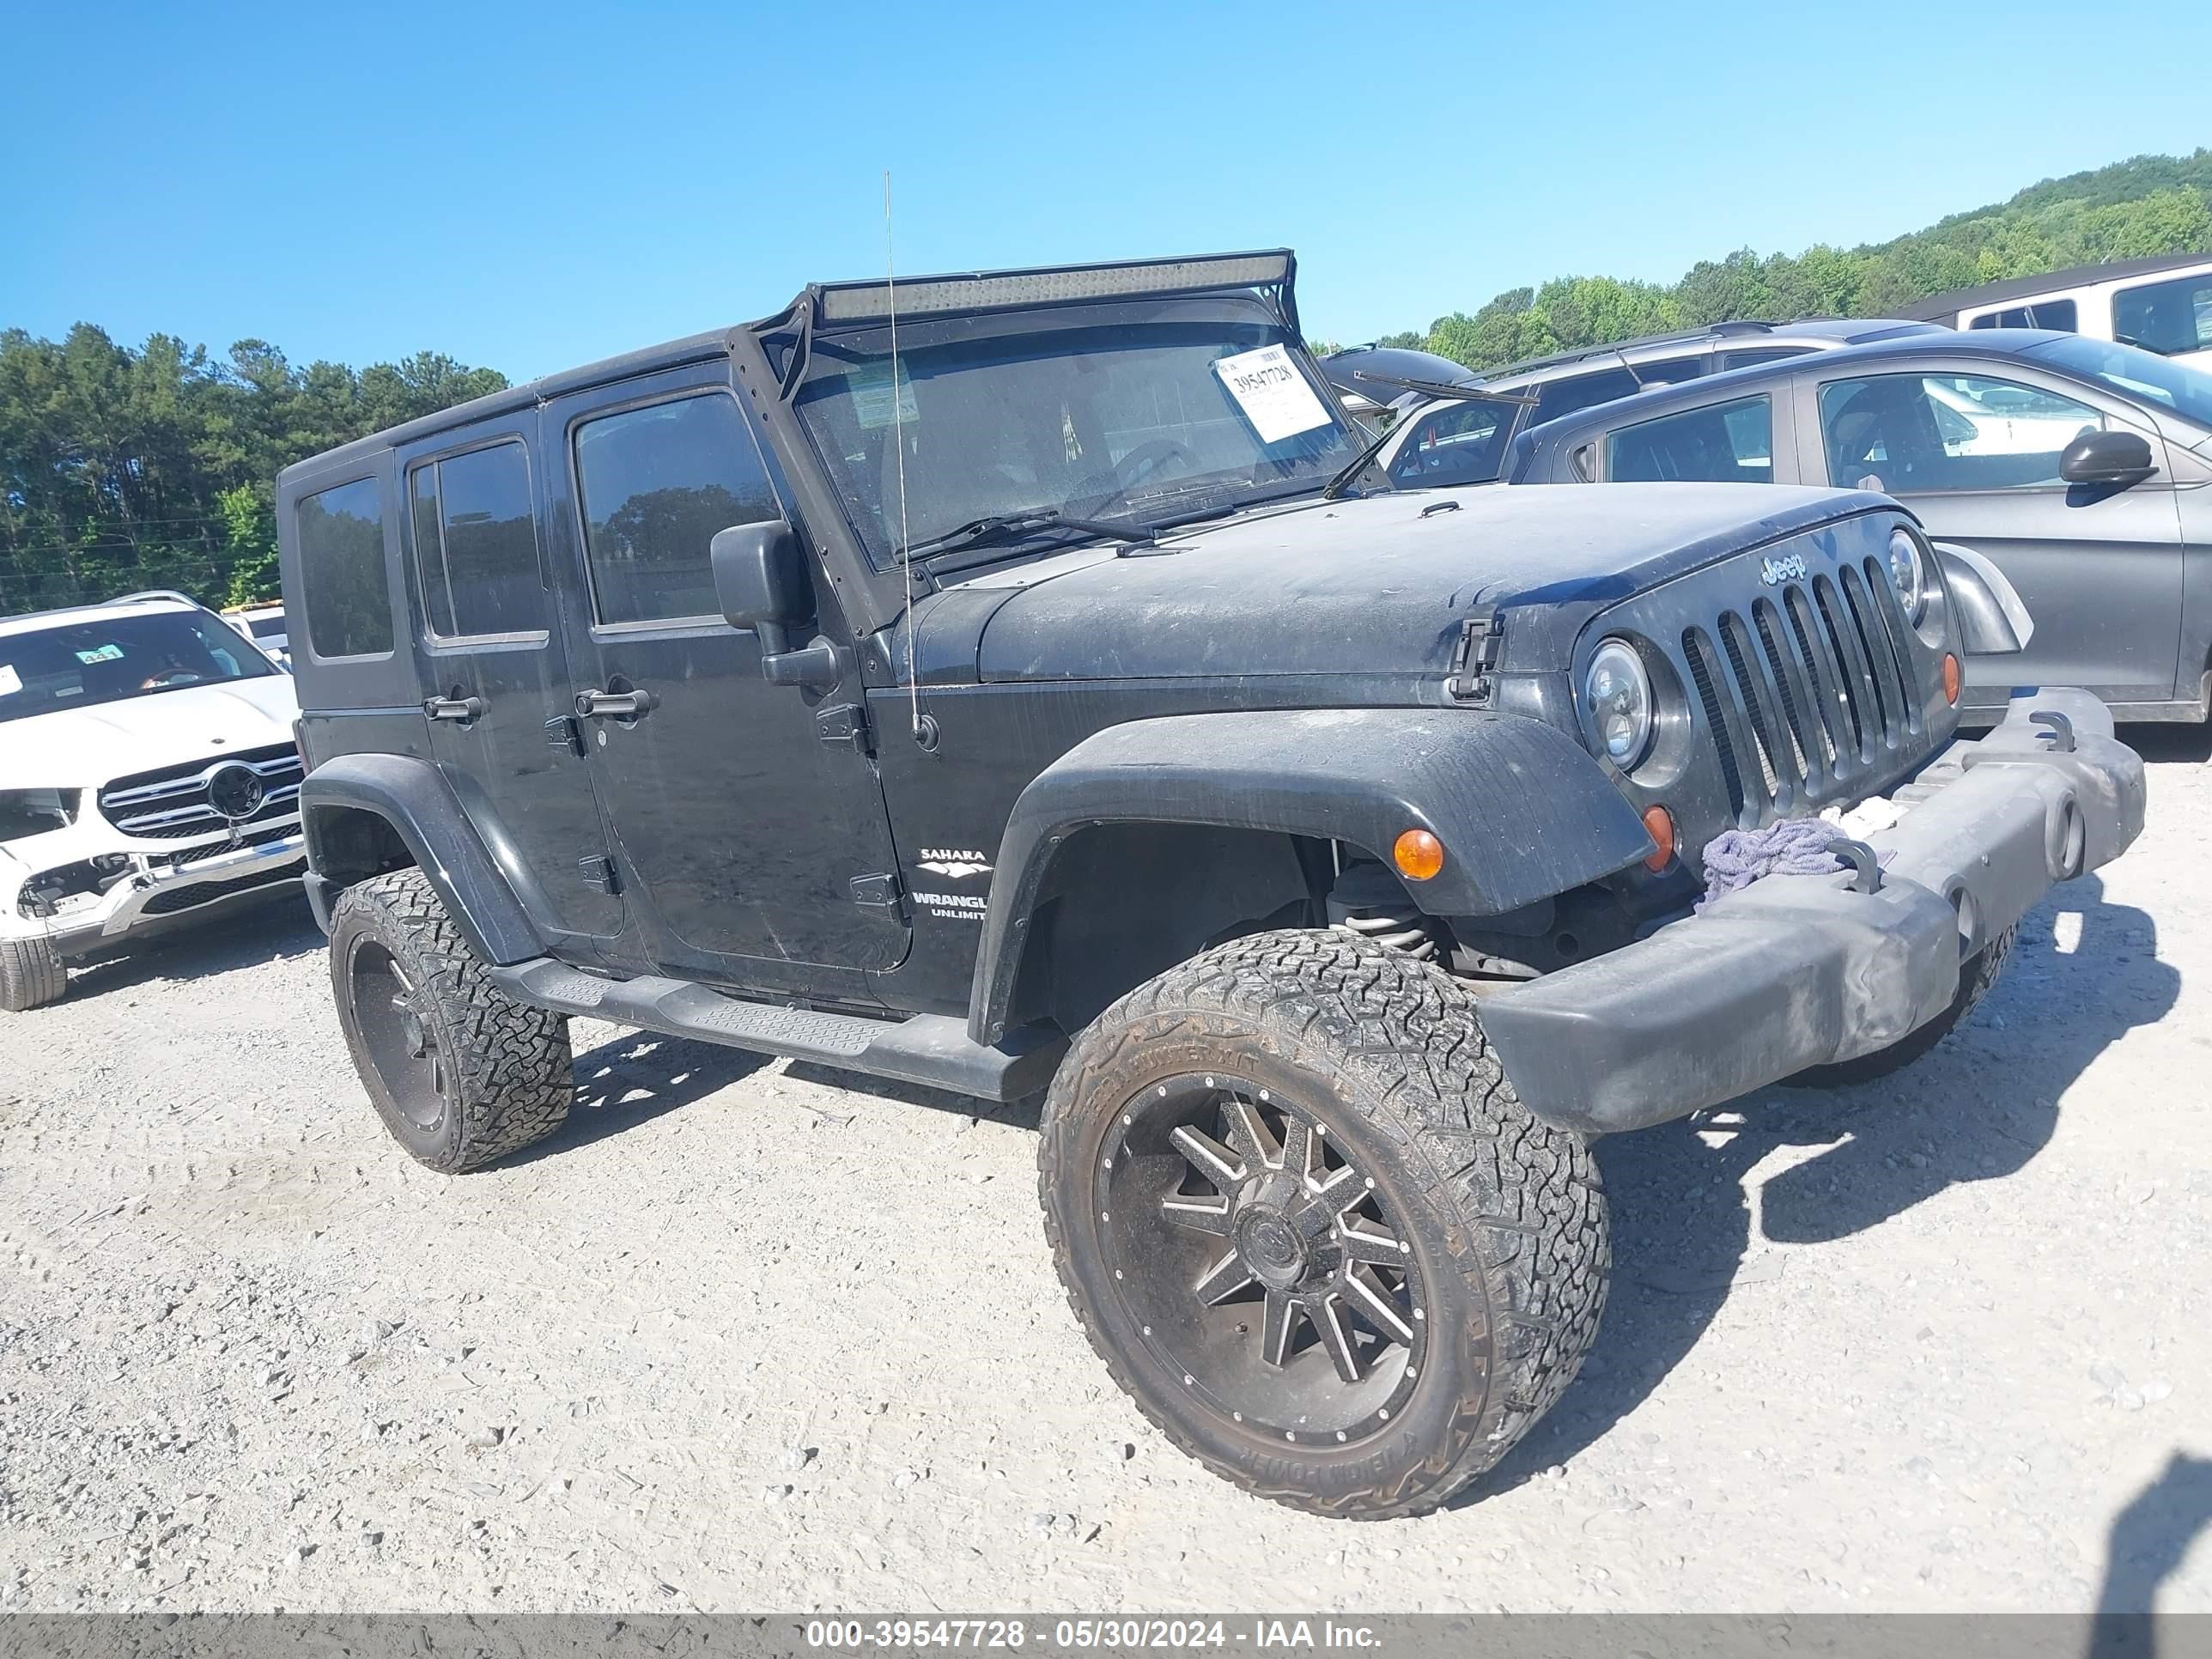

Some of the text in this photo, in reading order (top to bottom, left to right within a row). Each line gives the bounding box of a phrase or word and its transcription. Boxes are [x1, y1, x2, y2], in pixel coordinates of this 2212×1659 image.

[1234, 364, 1292, 393] 39547728
[1761, 554, 1807, 585] Jeep
[921, 848, 986, 860] SAHARA
[912, 892, 988, 908] WRANGL
[931, 908, 986, 921] UNLIMIT
